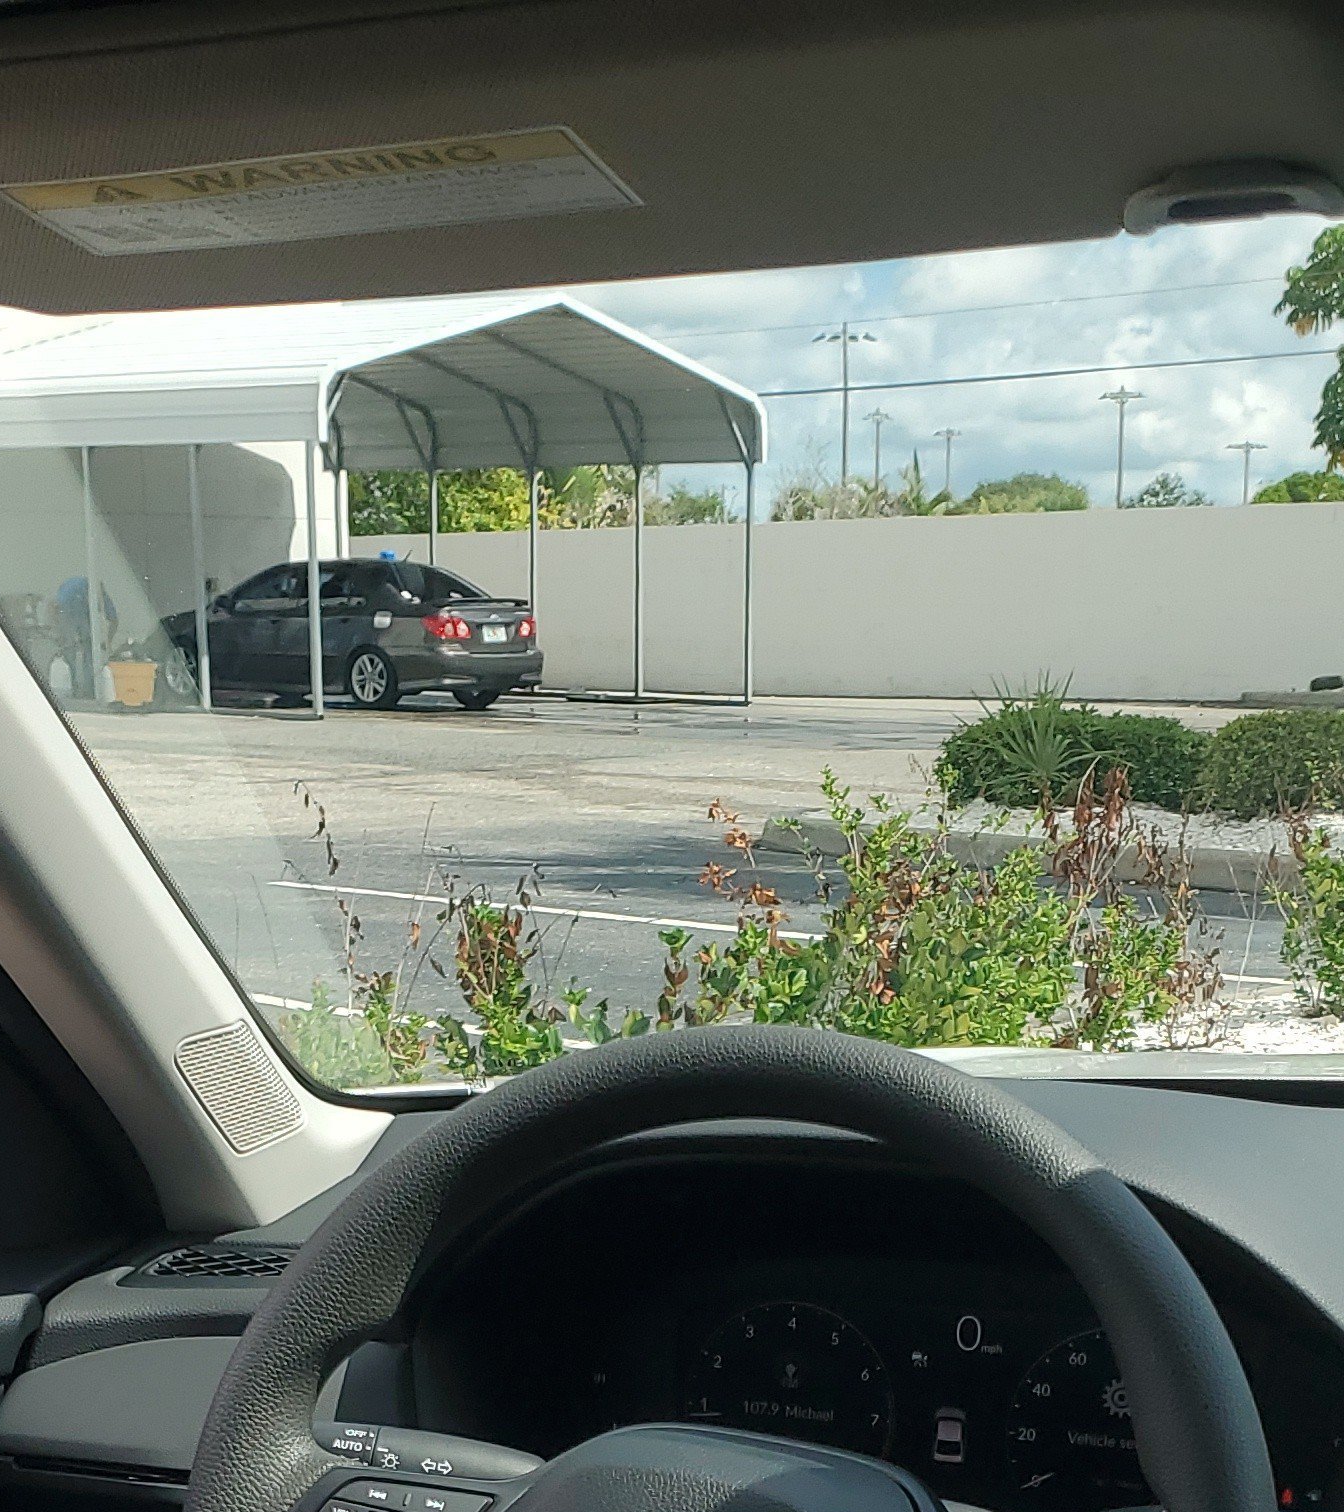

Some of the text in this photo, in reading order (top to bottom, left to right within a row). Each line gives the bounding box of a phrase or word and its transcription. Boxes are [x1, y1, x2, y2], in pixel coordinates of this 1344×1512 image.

[167, 144, 497, 194] WARNING
[787, 1317, 797, 1330] 4
[745, 1324, 754, 1338] 3
[956, 1315, 981, 1352] 0
[831, 1332, 840, 1346] 5
[713, 1355, 723, 1369] 2
[1068, 1352, 1087, 1366] 60
[861, 1368, 870, 1381] 6
[1032, 1383, 1050, 1398] 40
[743, 1400, 779, 1416] 107.9
[870, 1414, 880, 1428] 7
[1018, 1428, 1036, 1442] 20
[1067, 1429, 1116, 1449] Vehicle
[331, 1438, 363, 1453] AUTO
